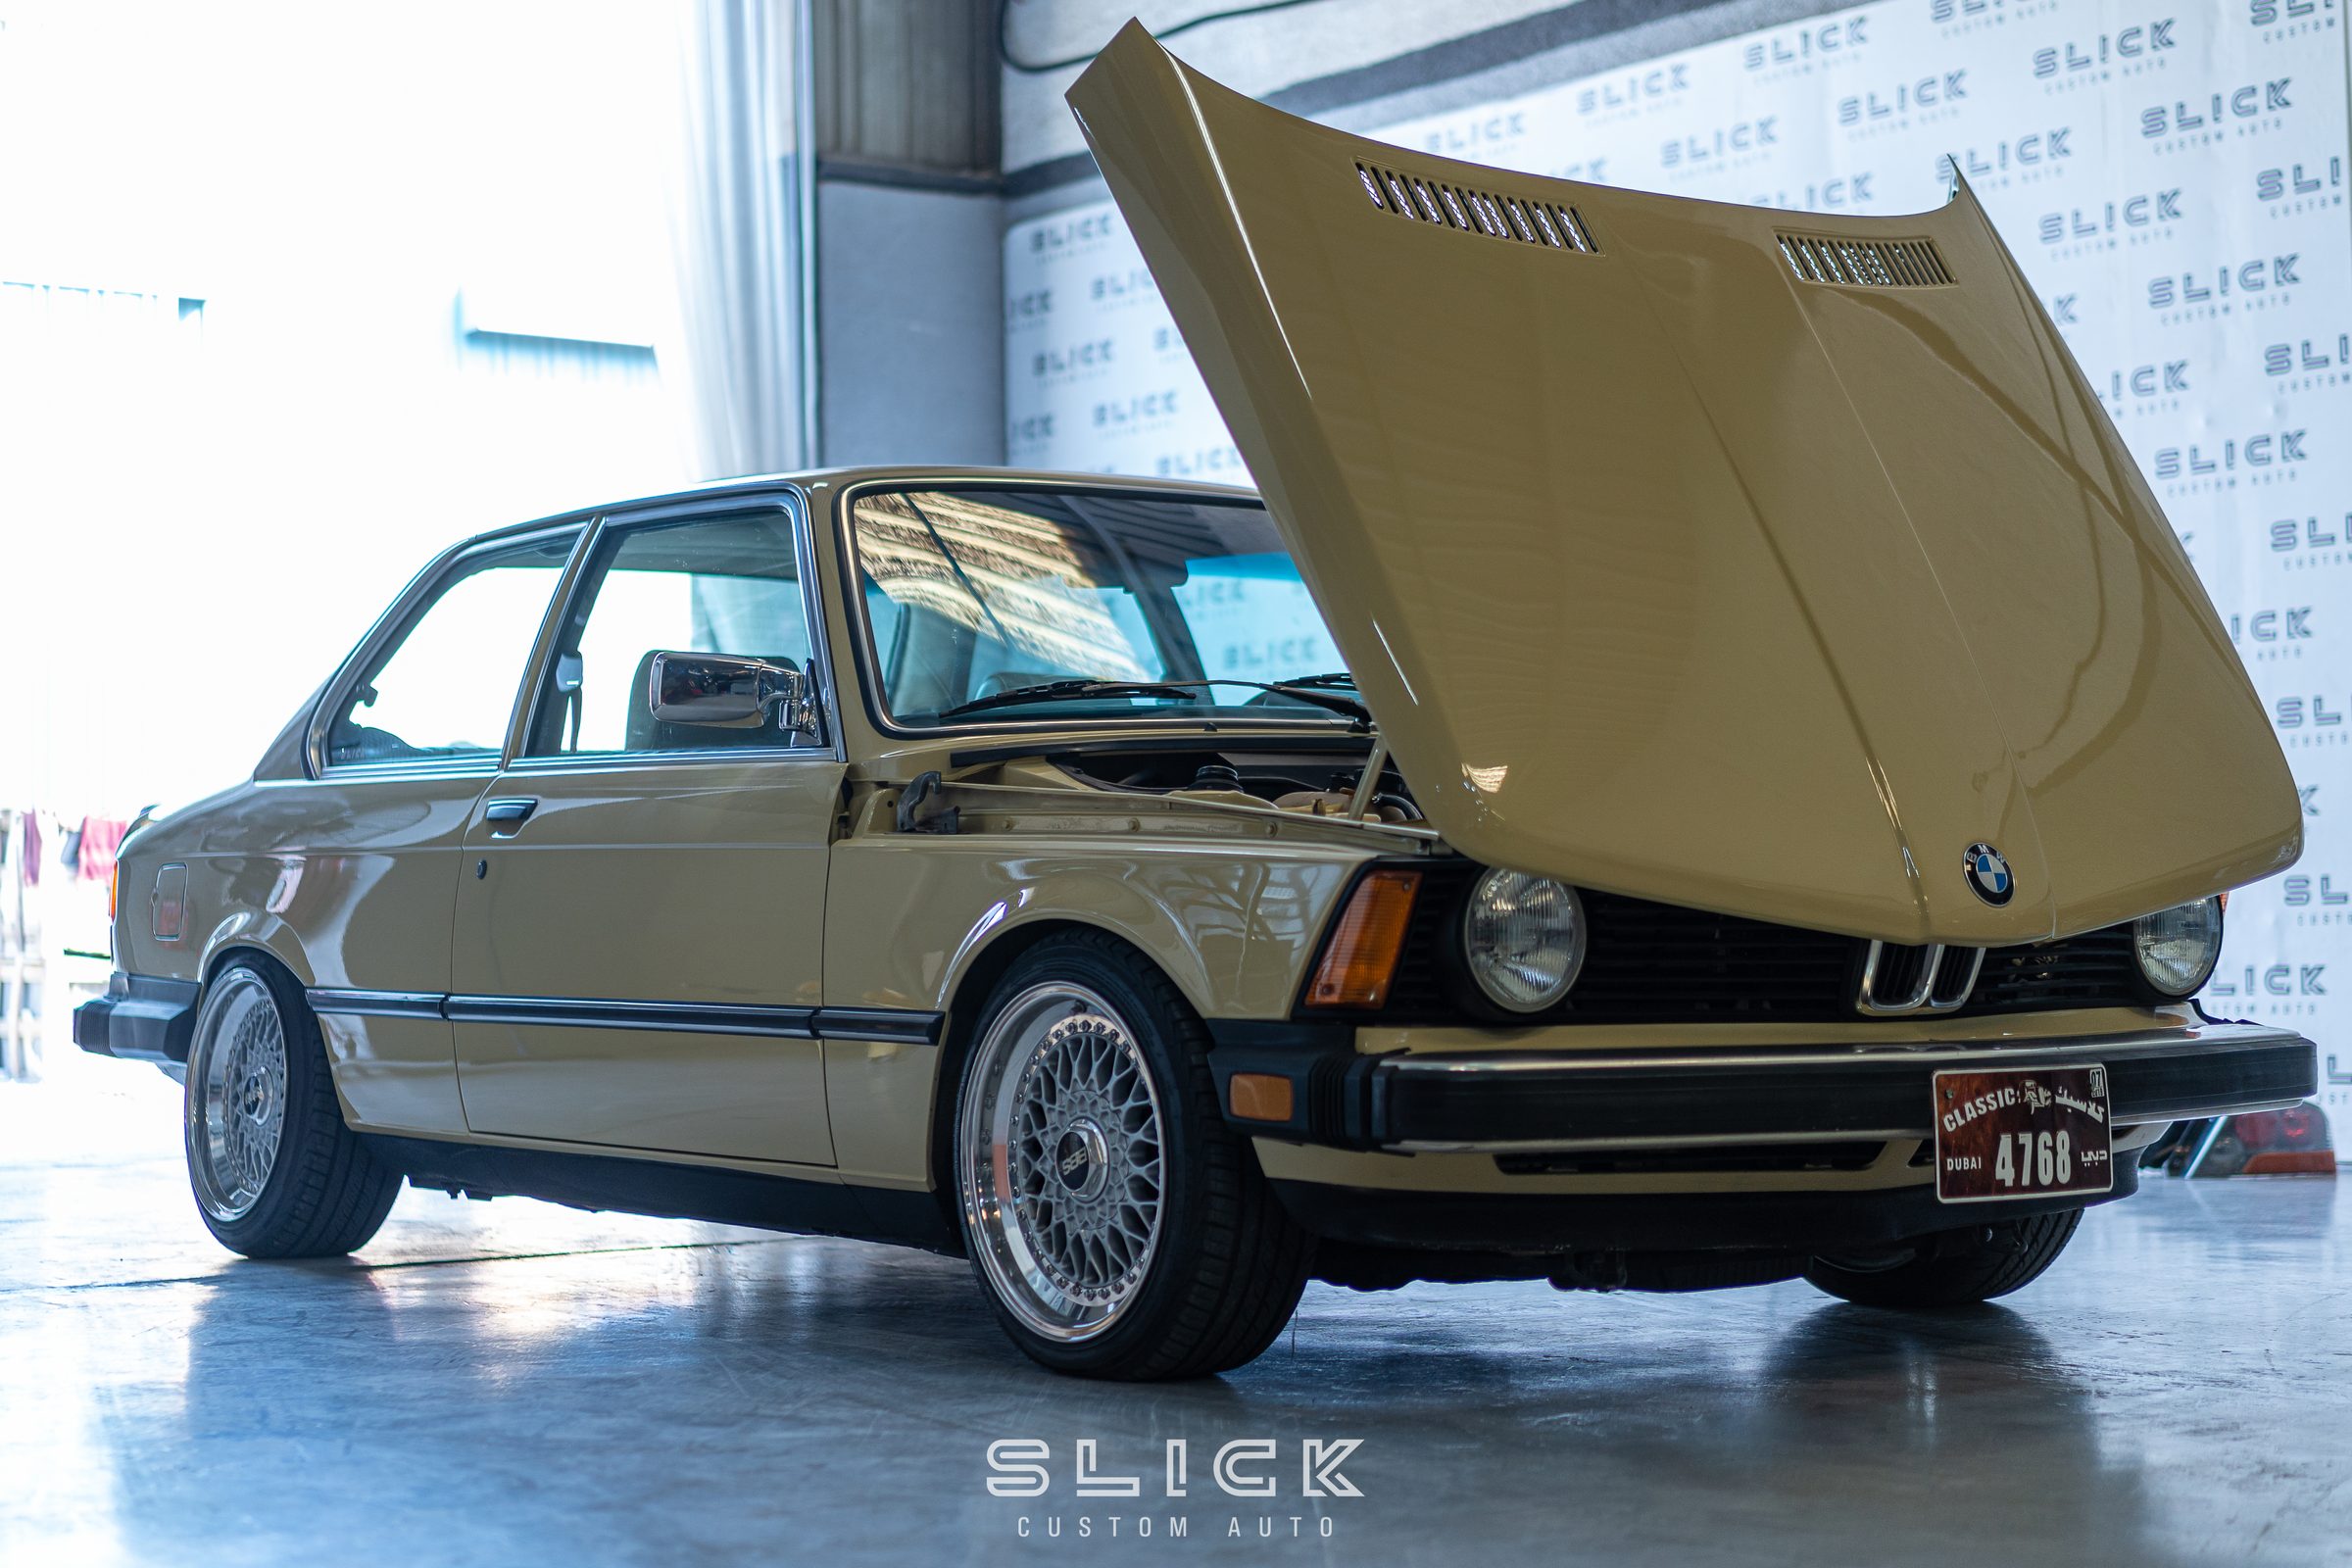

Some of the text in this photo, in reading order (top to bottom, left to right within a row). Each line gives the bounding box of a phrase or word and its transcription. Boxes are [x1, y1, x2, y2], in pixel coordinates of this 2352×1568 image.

[1742, 15, 1870, 73] SLICK
[2032, 17, 2178, 80] SLICK
[1576, 62, 1691, 117] SLICK
[1838, 67, 1970, 127] SLICK
[2140, 75, 2294, 140] SLICK
[1659, 114, 1780, 169] SLICK
[2037, 186, 2185, 246] SLICK
[2146, 251, 2303, 310] SLICK
[2097, 358, 2191, 402] ICK
[2153, 426, 2309, 481] SLICK
[2230, 605, 2313, 645] ICK
[1967, 845, 2006, 863] BMW
[2209, 962, 2328, 997] LICK
[1943, 1088, 2016, 1133] CLASSIC
[1061, 1147, 1088, 1176] BBS
[1946, 1156, 1982, 1171] DUBAI
[1995, 1130, 2071, 1187] 4768
[2081, 1150, 2107, 1166] دبي
